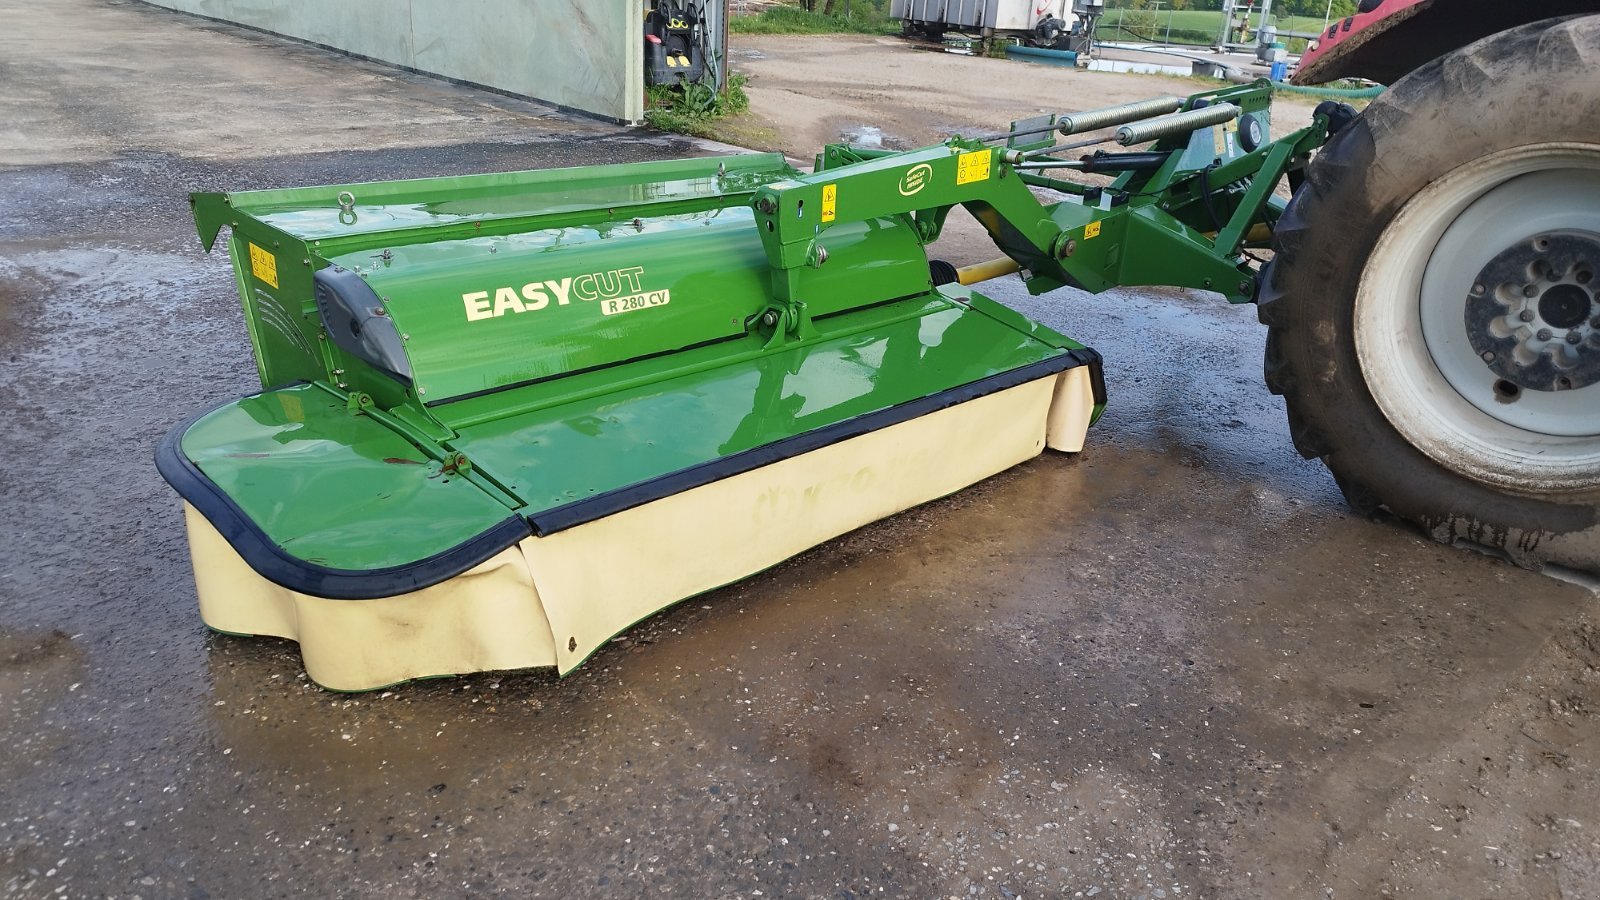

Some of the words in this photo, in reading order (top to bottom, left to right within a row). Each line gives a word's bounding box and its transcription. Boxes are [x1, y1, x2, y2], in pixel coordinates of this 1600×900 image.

[463, 266, 643, 321] EASYCUT
[608, 301, 619, 313] R
[622, 295, 645, 311] 280
[649, 291, 666, 306] CV
